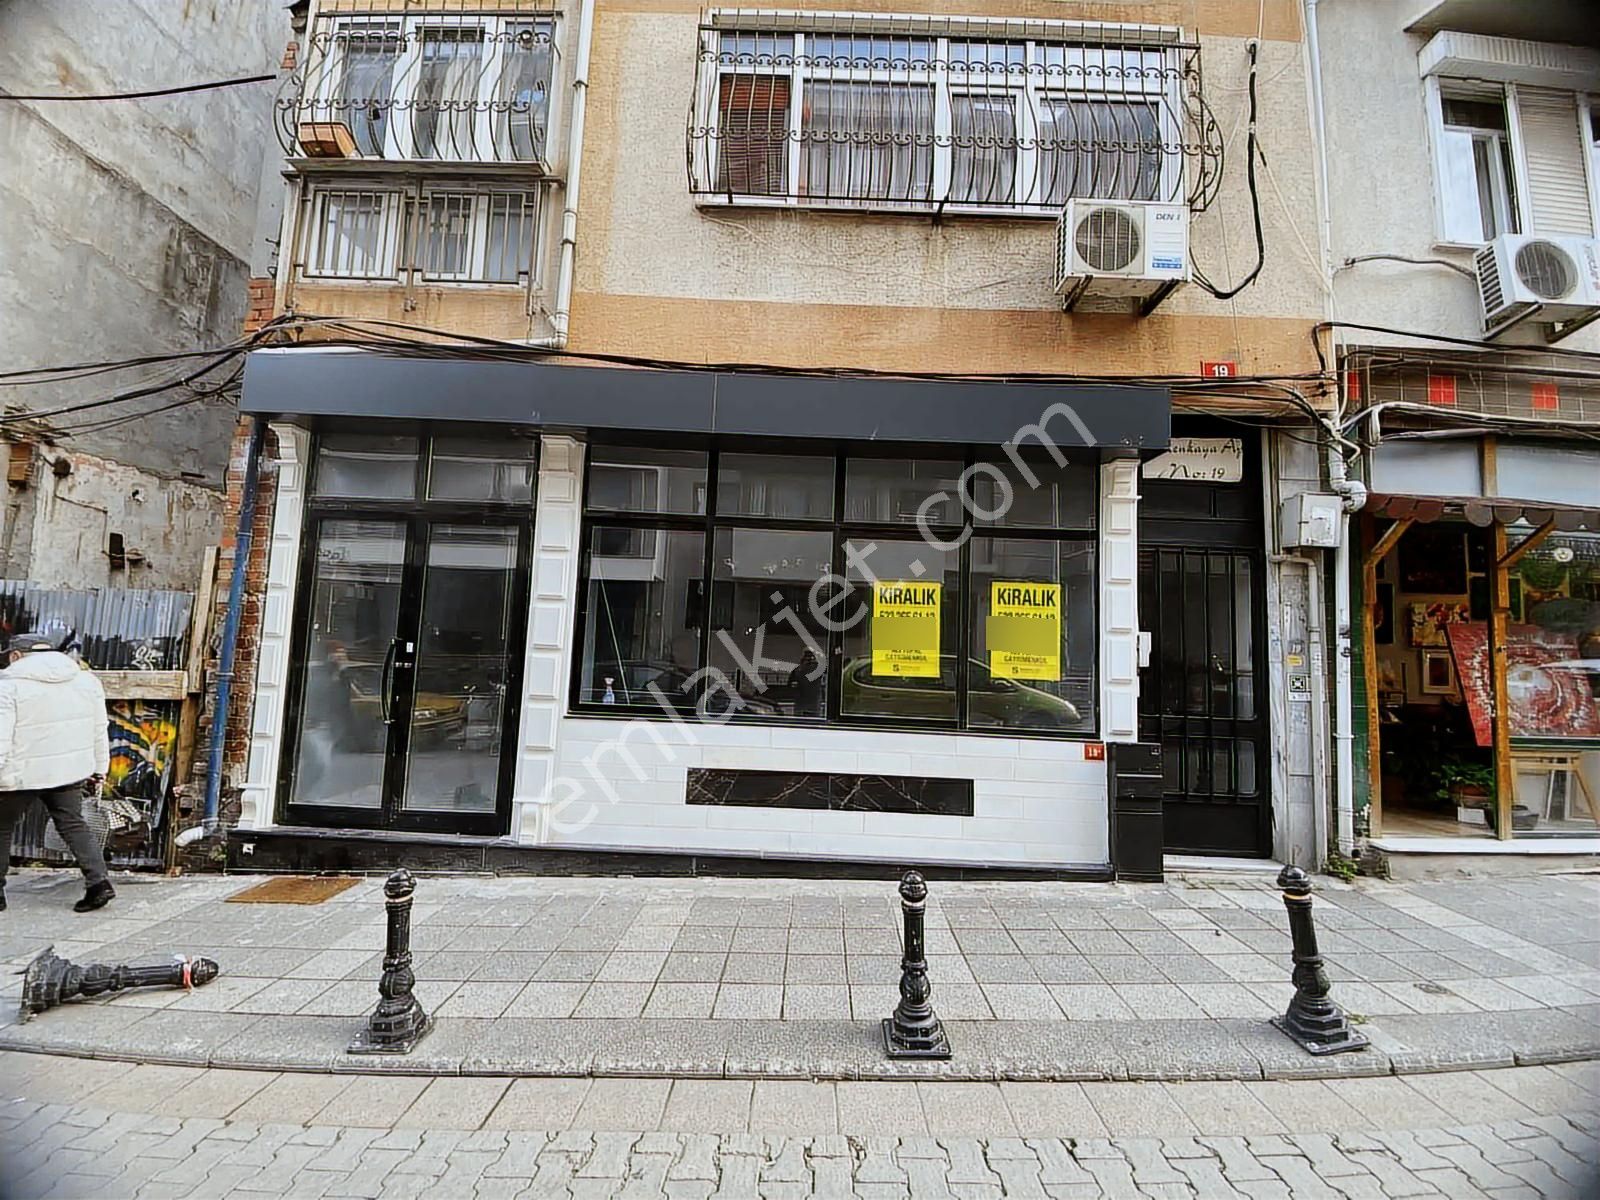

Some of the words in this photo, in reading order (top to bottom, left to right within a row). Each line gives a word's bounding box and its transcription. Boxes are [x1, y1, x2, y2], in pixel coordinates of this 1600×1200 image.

[1212, 365, 1228, 377] 19
[1169, 440, 1217, 459] enkaya
[1212, 468, 1225, 478] 19
